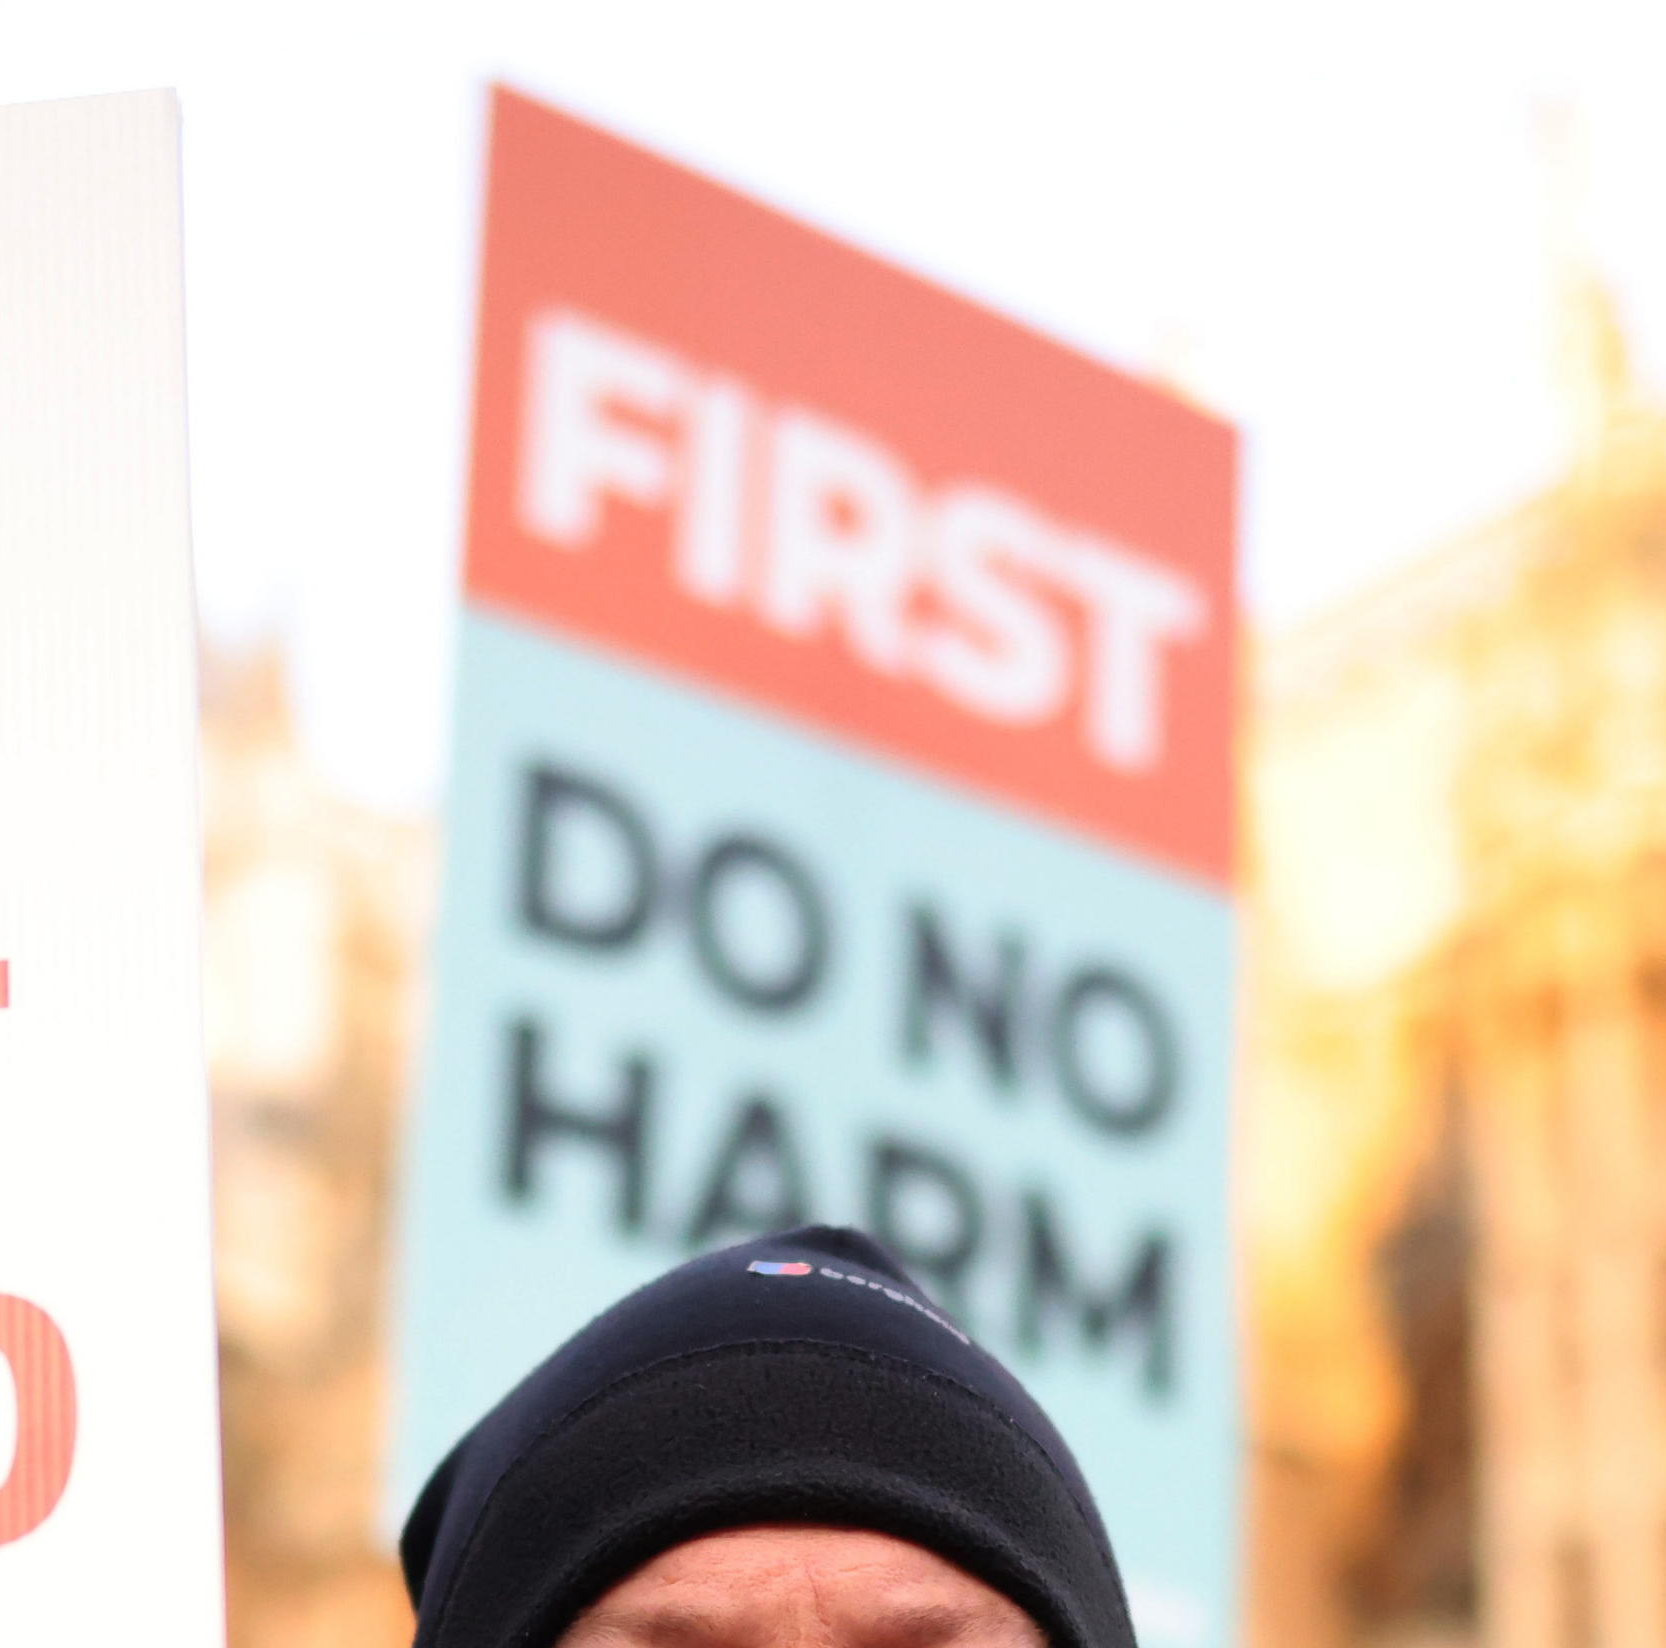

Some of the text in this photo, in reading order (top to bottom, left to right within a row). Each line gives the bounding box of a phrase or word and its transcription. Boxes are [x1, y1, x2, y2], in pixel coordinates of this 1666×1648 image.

[523, 318, 1201, 764] FIRST
[513, 760, 1183, 1142] DO NO
[496, 1026, 1171, 1398] HARM
[819, 1267, 971, 1345] bergh
